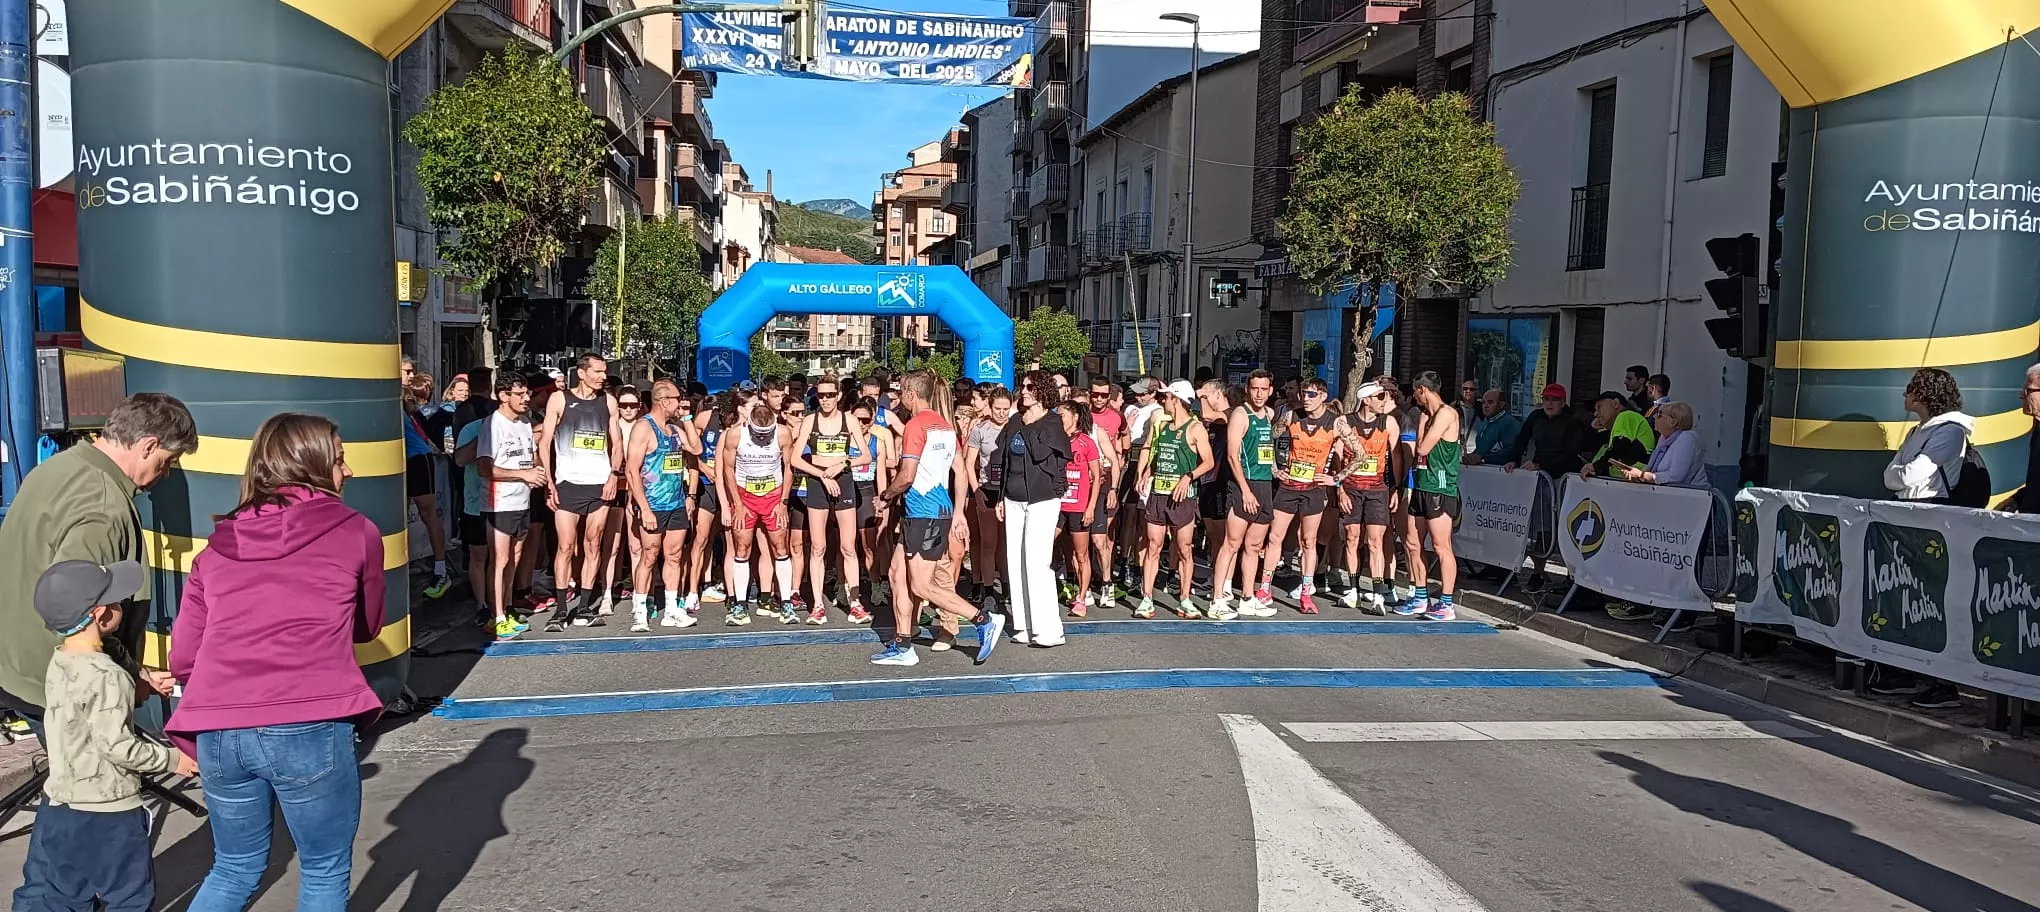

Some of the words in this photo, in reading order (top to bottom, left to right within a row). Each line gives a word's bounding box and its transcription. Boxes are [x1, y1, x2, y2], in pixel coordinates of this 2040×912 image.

[827, 16, 891, 34] ARATON
[896, 19, 917, 35] DE
[692, 27, 744, 47] XXXVI
[745, 54, 765, 68] 24
[767, 54, 780, 69] Y
[834, 60, 881, 77] MAYO
[900, 63, 933, 79] DEL
[935, 65, 975, 80] 2025
[78, 138, 352, 176] Ayuntamiento
[788, 284, 817, 294] ALTO
[820, 282, 873, 294] GÁLLEGO
[583, 438, 595, 446] 64
[1465, 496, 1528, 517] Ayuntamiento
